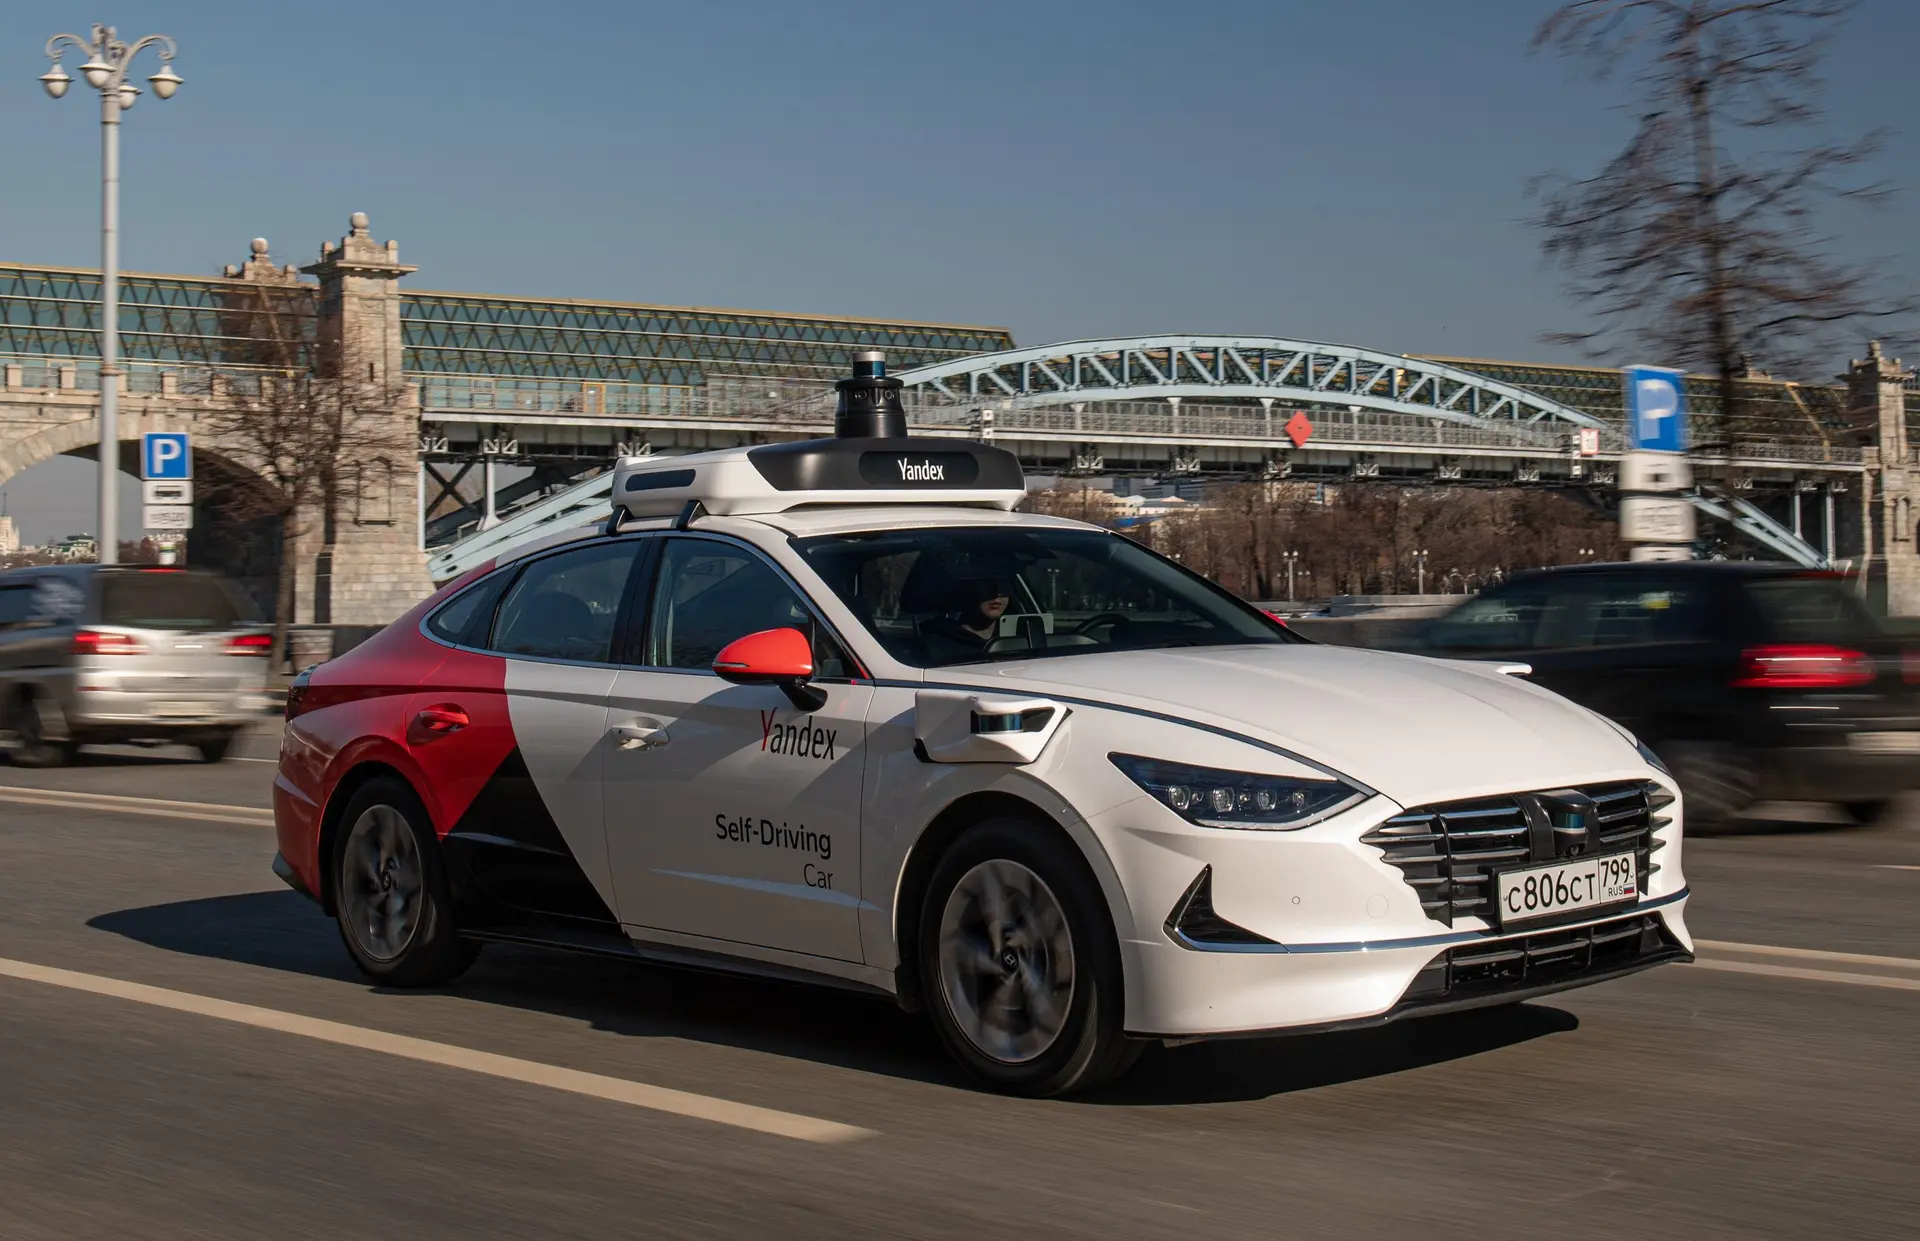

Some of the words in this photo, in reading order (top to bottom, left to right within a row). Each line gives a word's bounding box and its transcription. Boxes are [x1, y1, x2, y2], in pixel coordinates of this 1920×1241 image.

[1637, 379, 1678, 440] P
[153, 439, 181, 473] P
[898, 458, 944, 480] Yandex
[761, 706, 837, 760] Yandex
[716, 813, 831, 860] Self-Driving
[804, 863, 833, 890] Car
[1600, 857, 1630, 888] 799
[1608, 886, 1624, 897] RUS
